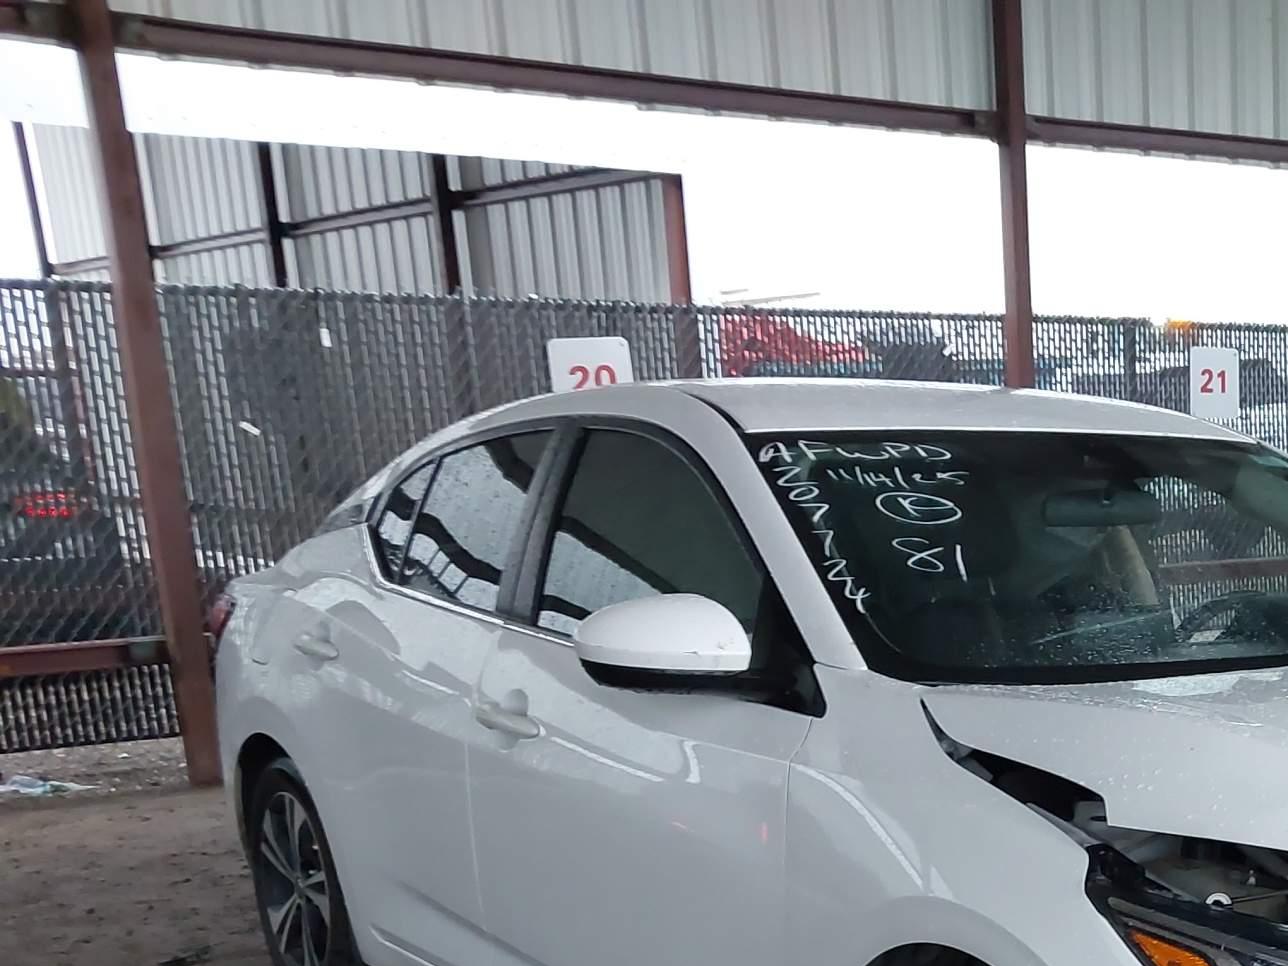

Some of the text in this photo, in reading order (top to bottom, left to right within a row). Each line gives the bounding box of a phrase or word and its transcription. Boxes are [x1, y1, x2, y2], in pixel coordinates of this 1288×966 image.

[568, 365, 617, 389] 20
[1200, 368, 1226, 393] 21
[826, 465, 970, 489] 11/14/25
[891, 537, 968, 582] 81
